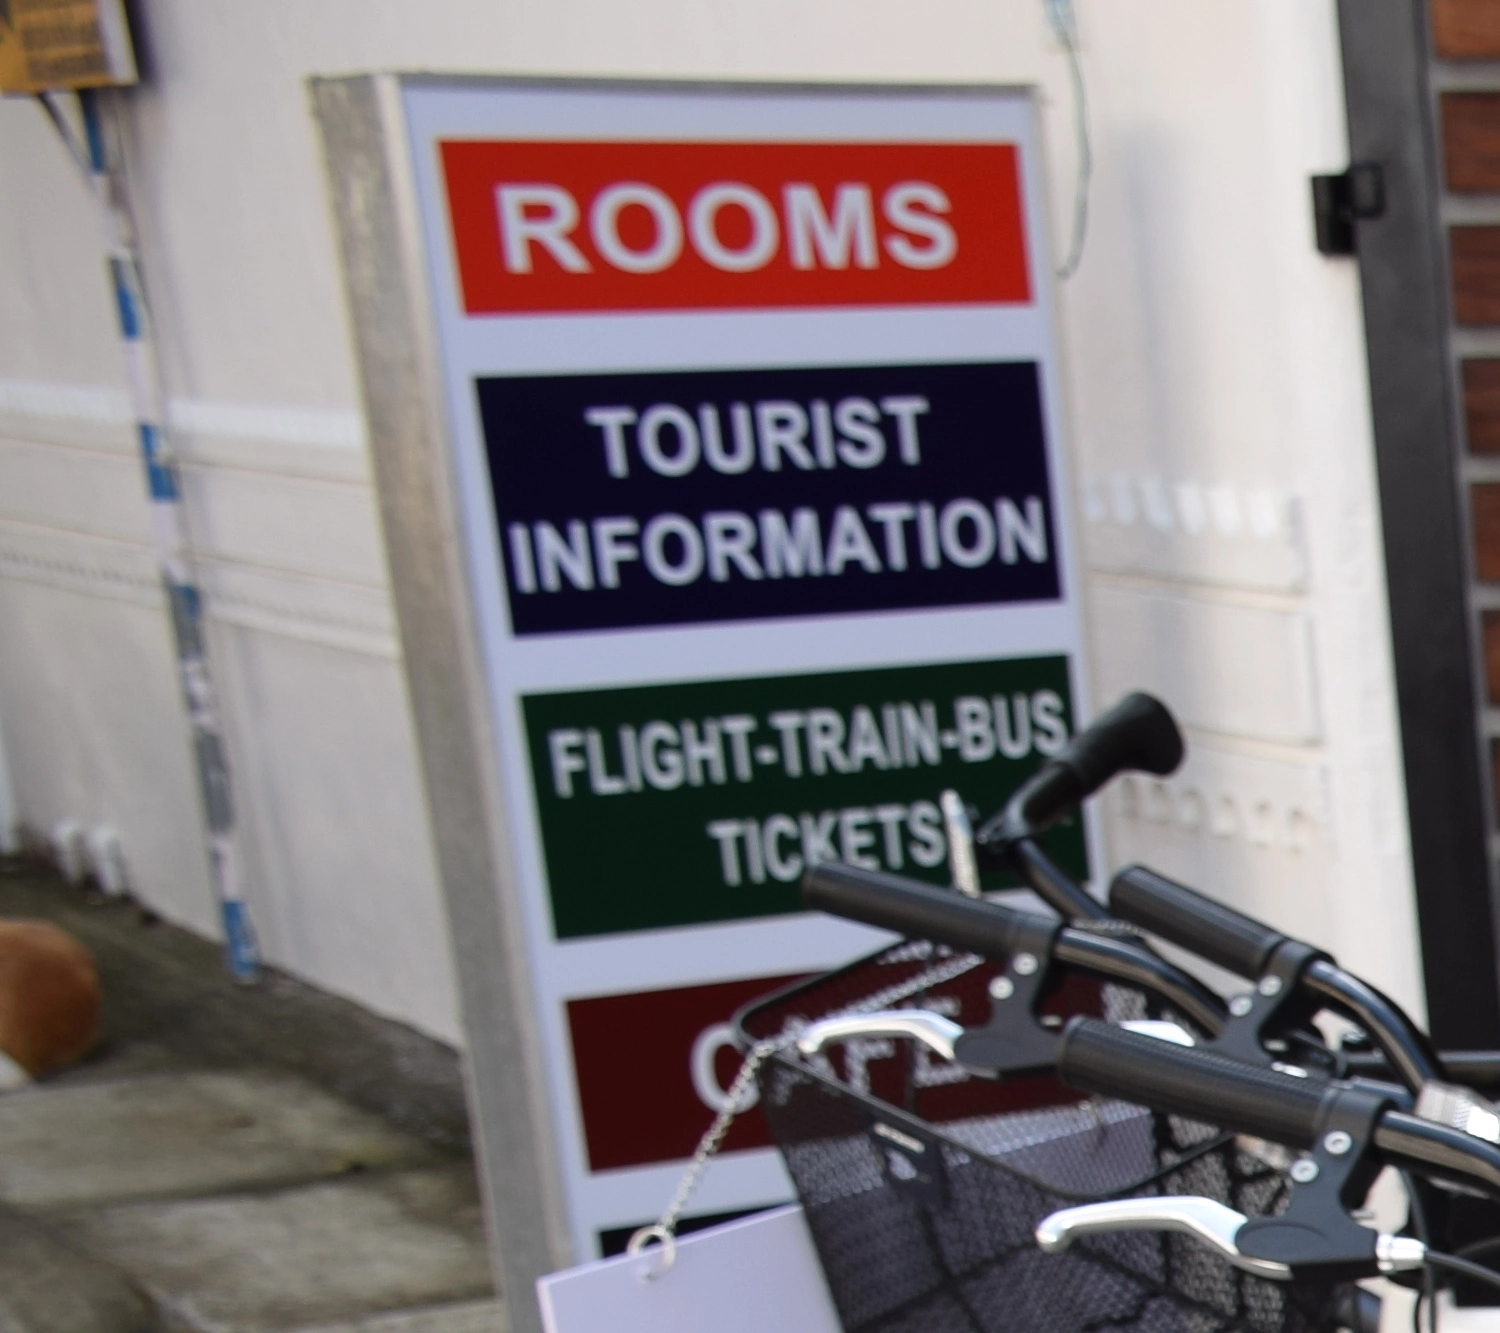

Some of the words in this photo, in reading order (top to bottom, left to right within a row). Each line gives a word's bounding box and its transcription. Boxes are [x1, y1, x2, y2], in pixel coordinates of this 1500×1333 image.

[494, 180, 959, 275] ROOMS
[584, 396, 929, 480] TOURIST
[507, 496, 1049, 594] INFORMATION
[547, 689, 1070, 799] FLIGHT-TRAIN-BUS
[706, 801, 946, 887] TICKETS
